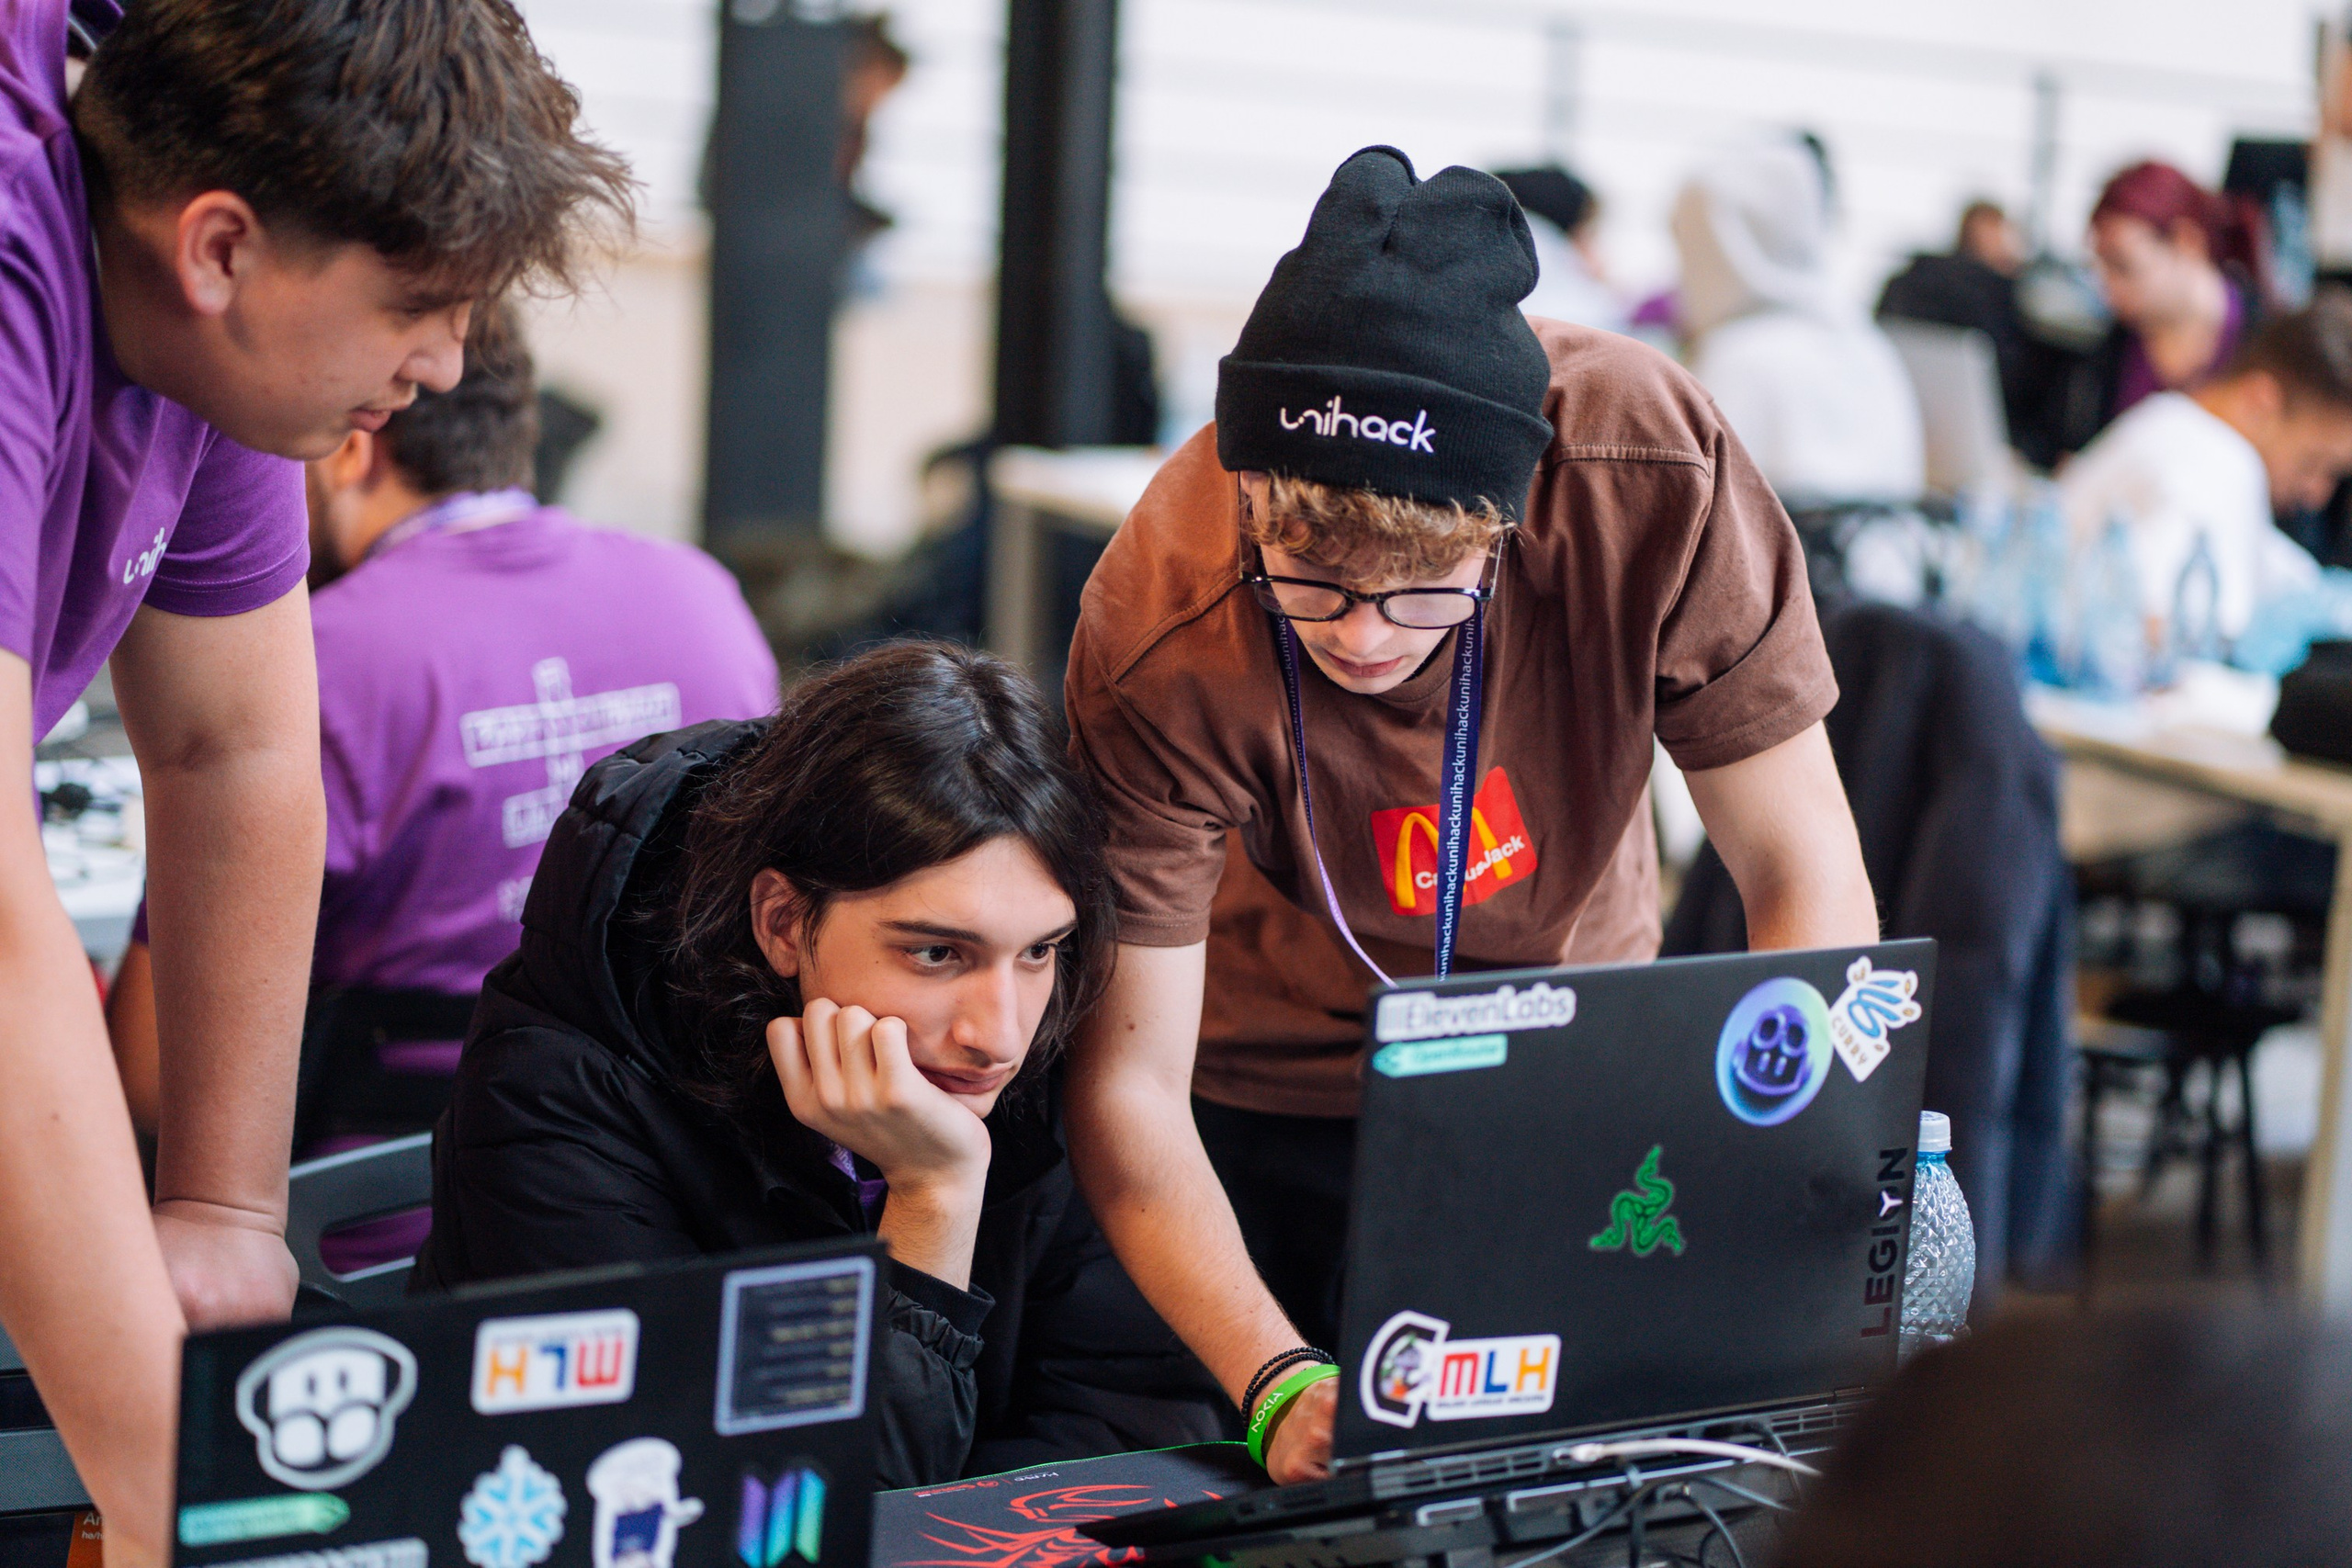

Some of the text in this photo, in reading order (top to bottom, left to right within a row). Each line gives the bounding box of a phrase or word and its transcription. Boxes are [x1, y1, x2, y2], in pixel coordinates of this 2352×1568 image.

[1281, 395, 1436, 453] unihack
[1860, 1147, 1908, 1338] LEGION
[1439, 1346, 1552, 1397] MLH
